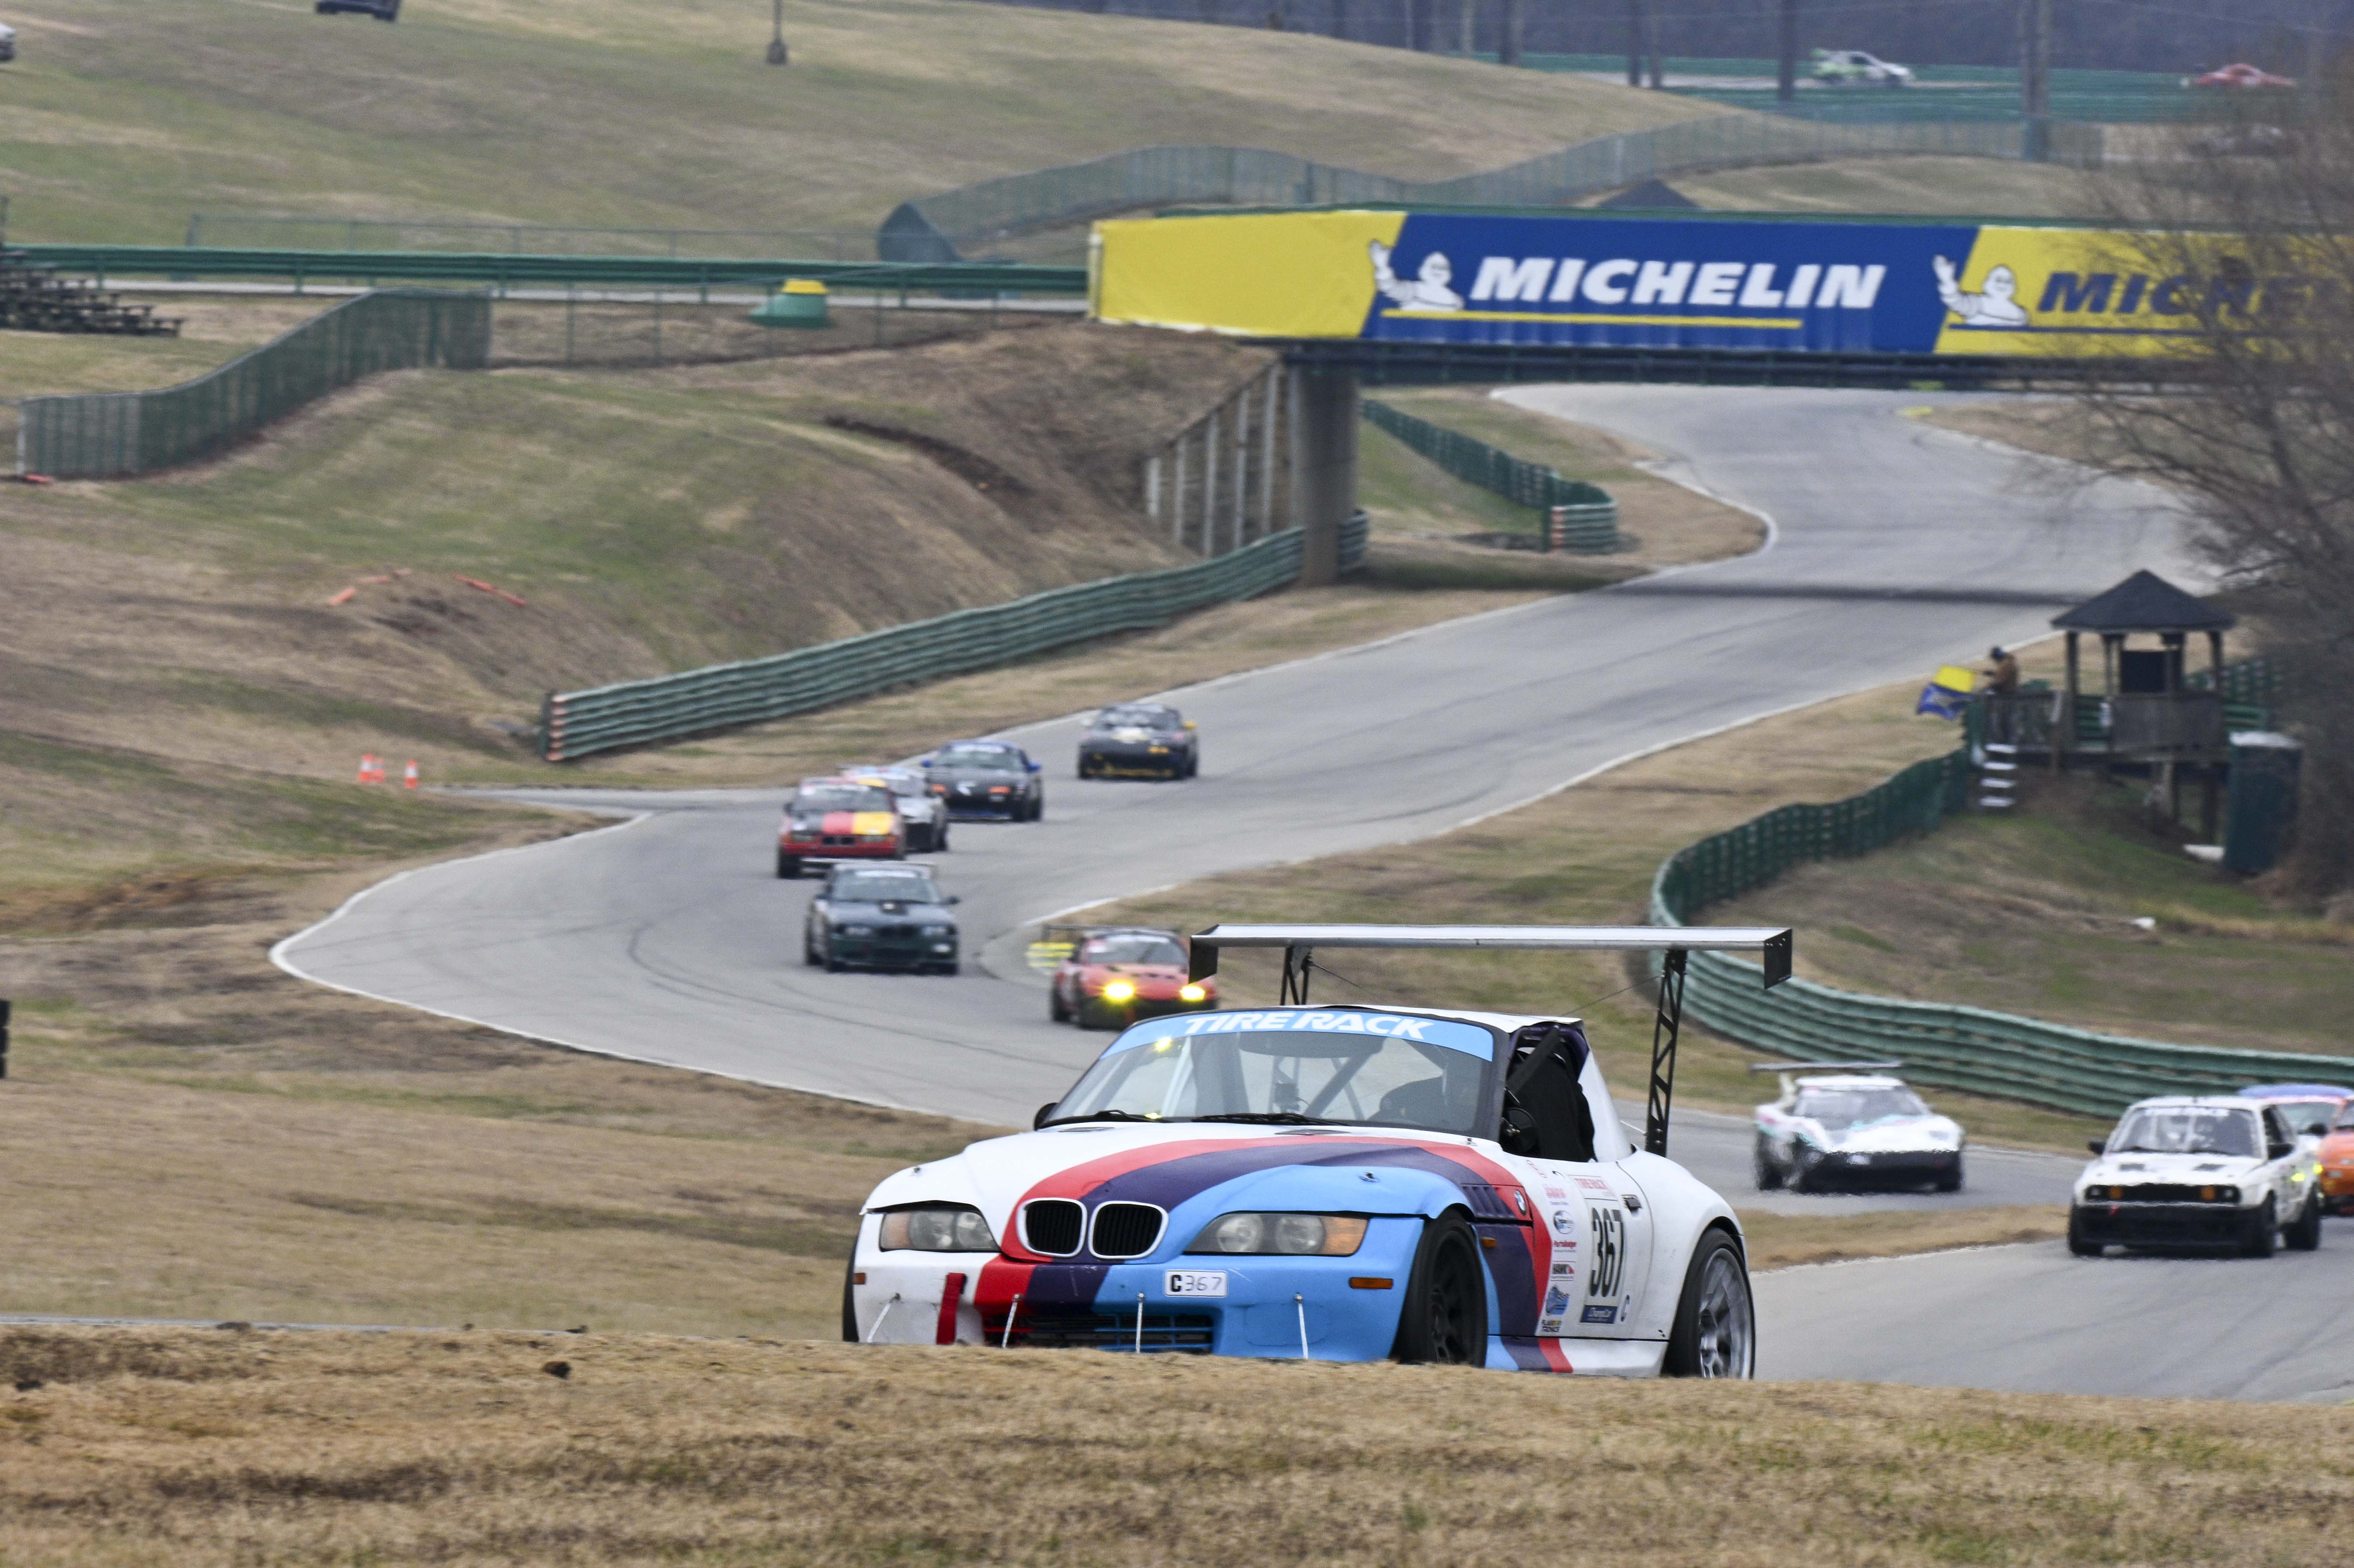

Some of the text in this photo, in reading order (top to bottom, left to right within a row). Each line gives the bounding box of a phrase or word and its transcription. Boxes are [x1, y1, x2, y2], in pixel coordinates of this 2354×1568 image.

[1470, 257, 1886, 308] MICHELIN
[1184, 1012, 1434, 1039] TIRE RACK
[1589, 1207, 1625, 1298] 367
[1170, 1274, 1222, 1292] C367
